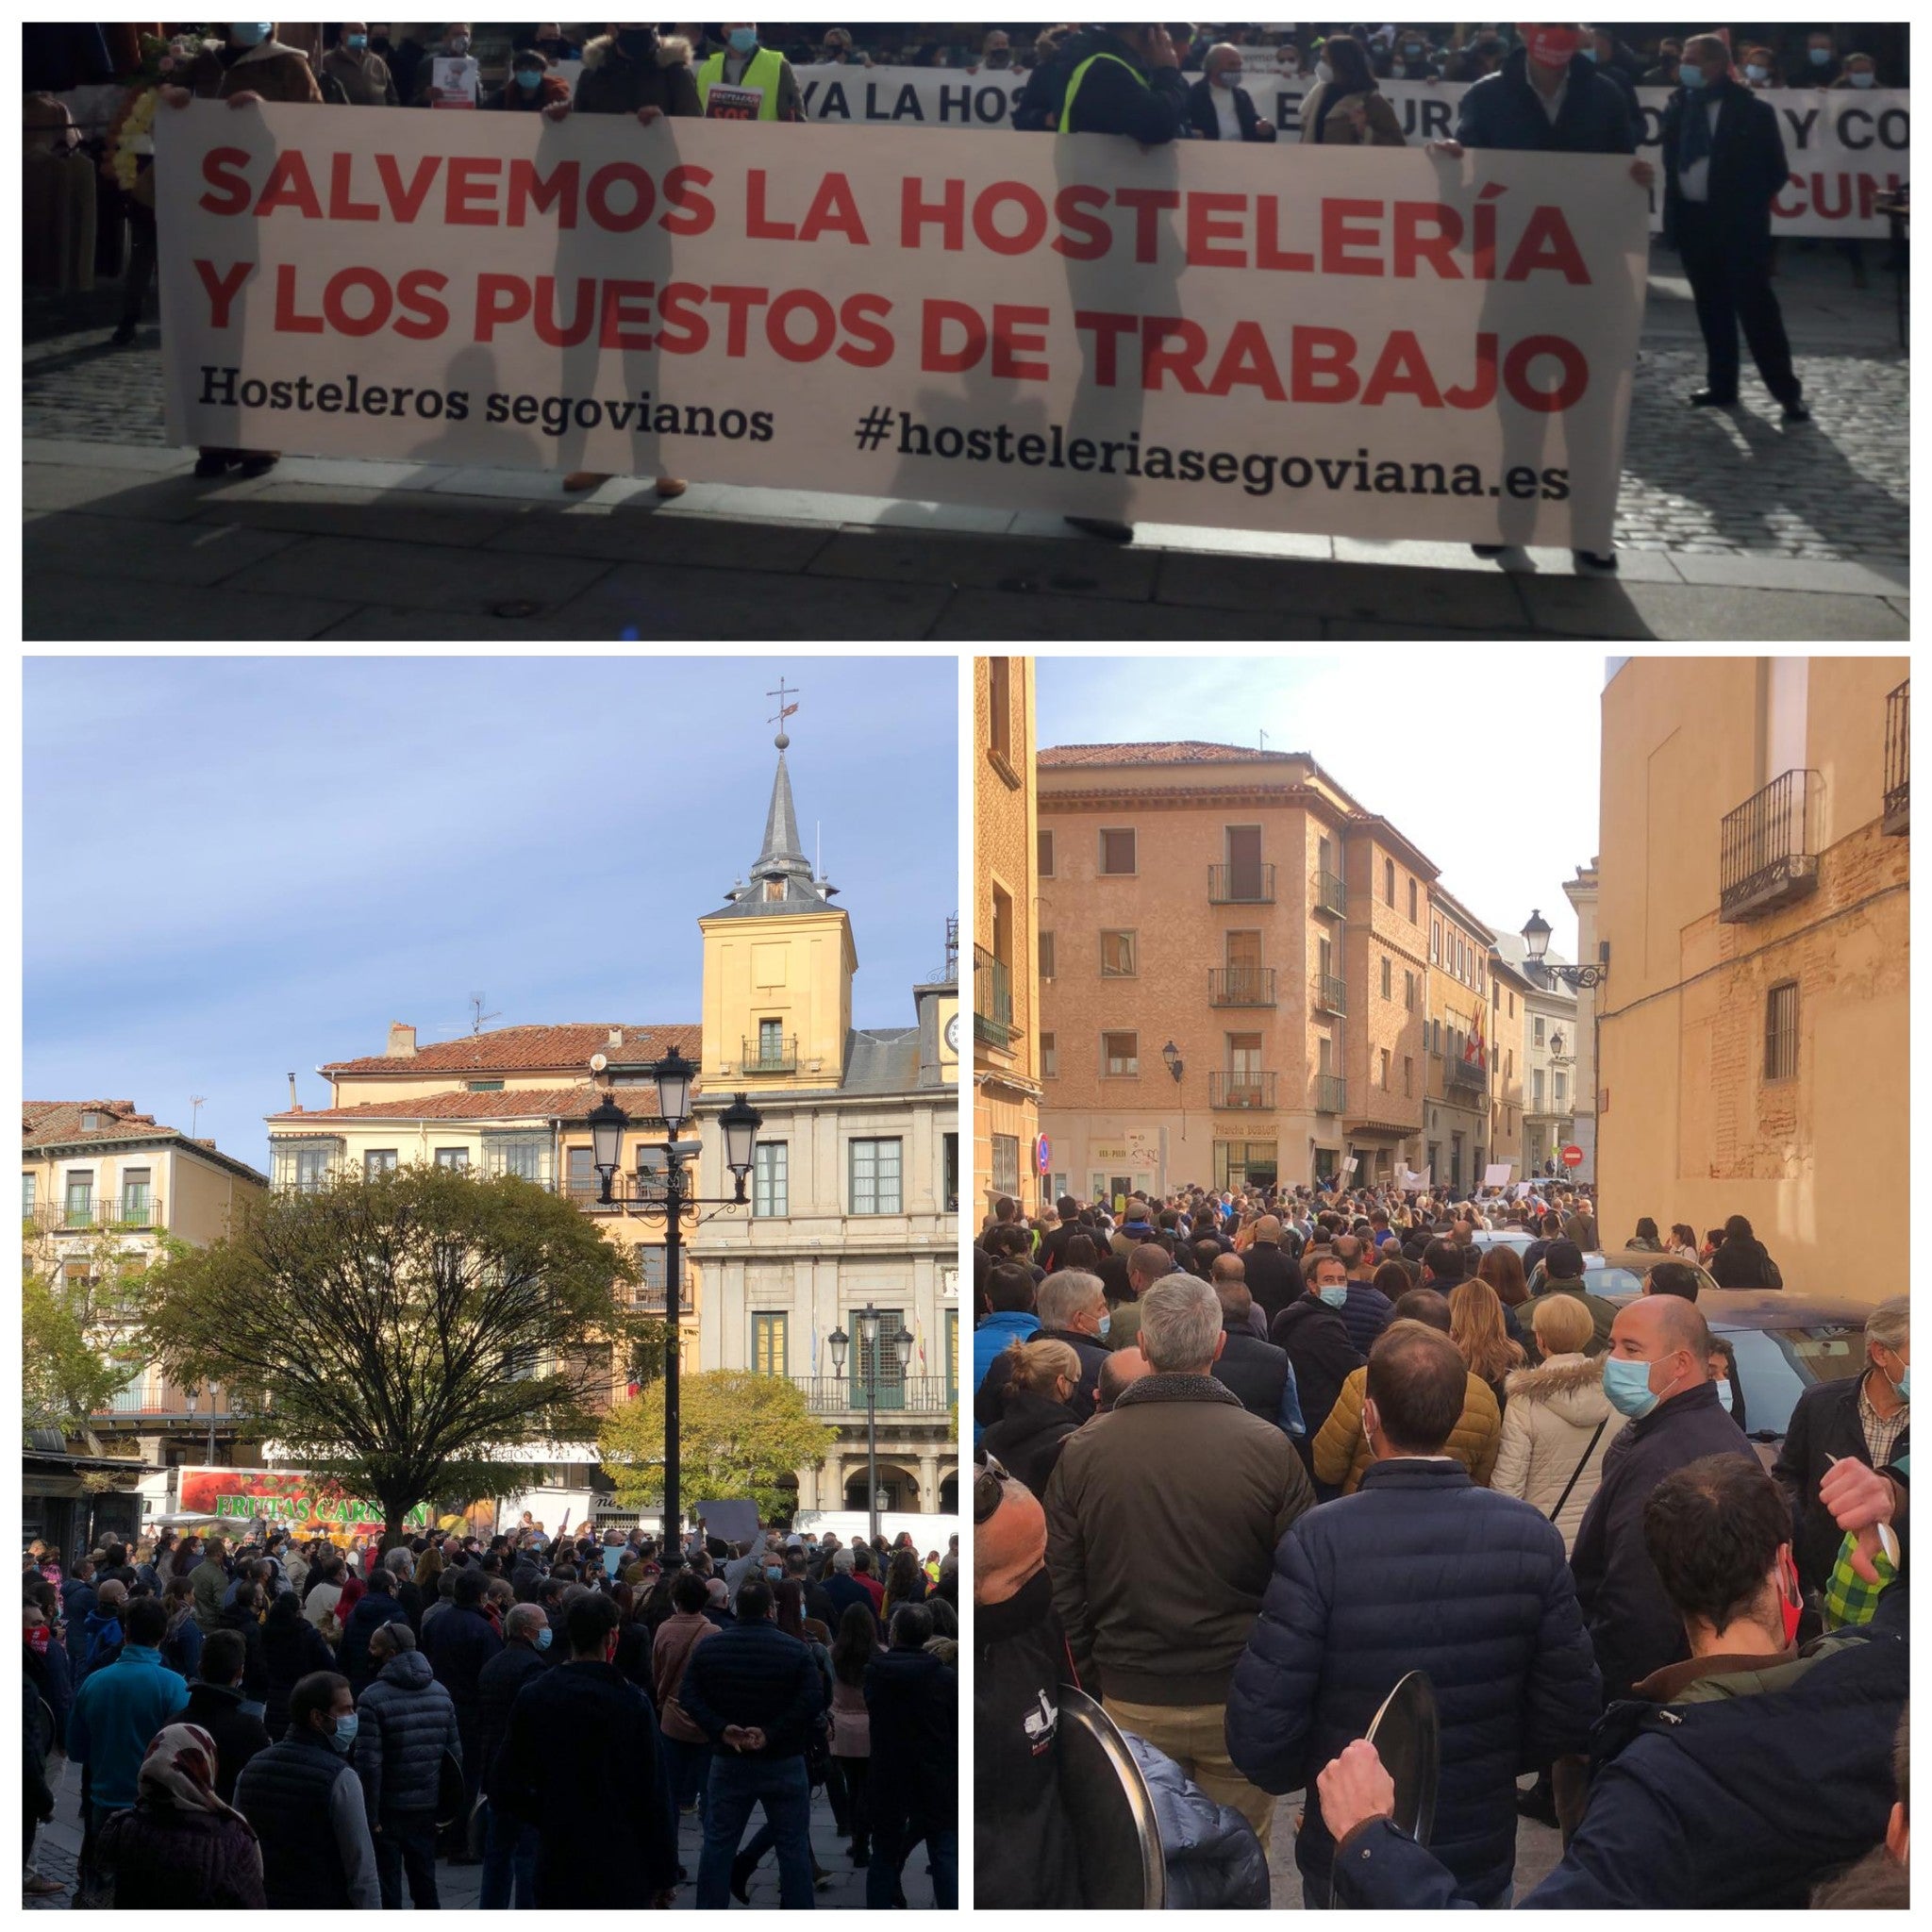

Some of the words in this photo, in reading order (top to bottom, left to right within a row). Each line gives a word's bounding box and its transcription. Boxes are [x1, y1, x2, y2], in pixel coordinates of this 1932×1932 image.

[866, 82, 924, 122] LA
[1783, 109, 1819, 149] Y
[199, 147, 715, 235] SALVEMOS
[746, 169, 869, 244] LA
[901, 177, 1591, 285] HOSTELERÍA
[192, 259, 253, 328] Y
[275, 264, 449, 340] LOS
[475, 274, 895, 368] PUESTOS
[922, 299, 1050, 381] DE
[1074, 311, 1590, 413] TRABAJO
[199, 366, 470, 422] Hosteleros
[486, 390, 774, 441] segovianos
[855, 405, 1571, 501] #hosteleriasegoviana.es
[215, 1494, 311, 1521] FRUTAS
[316, 1498, 429, 1527] CARMN
